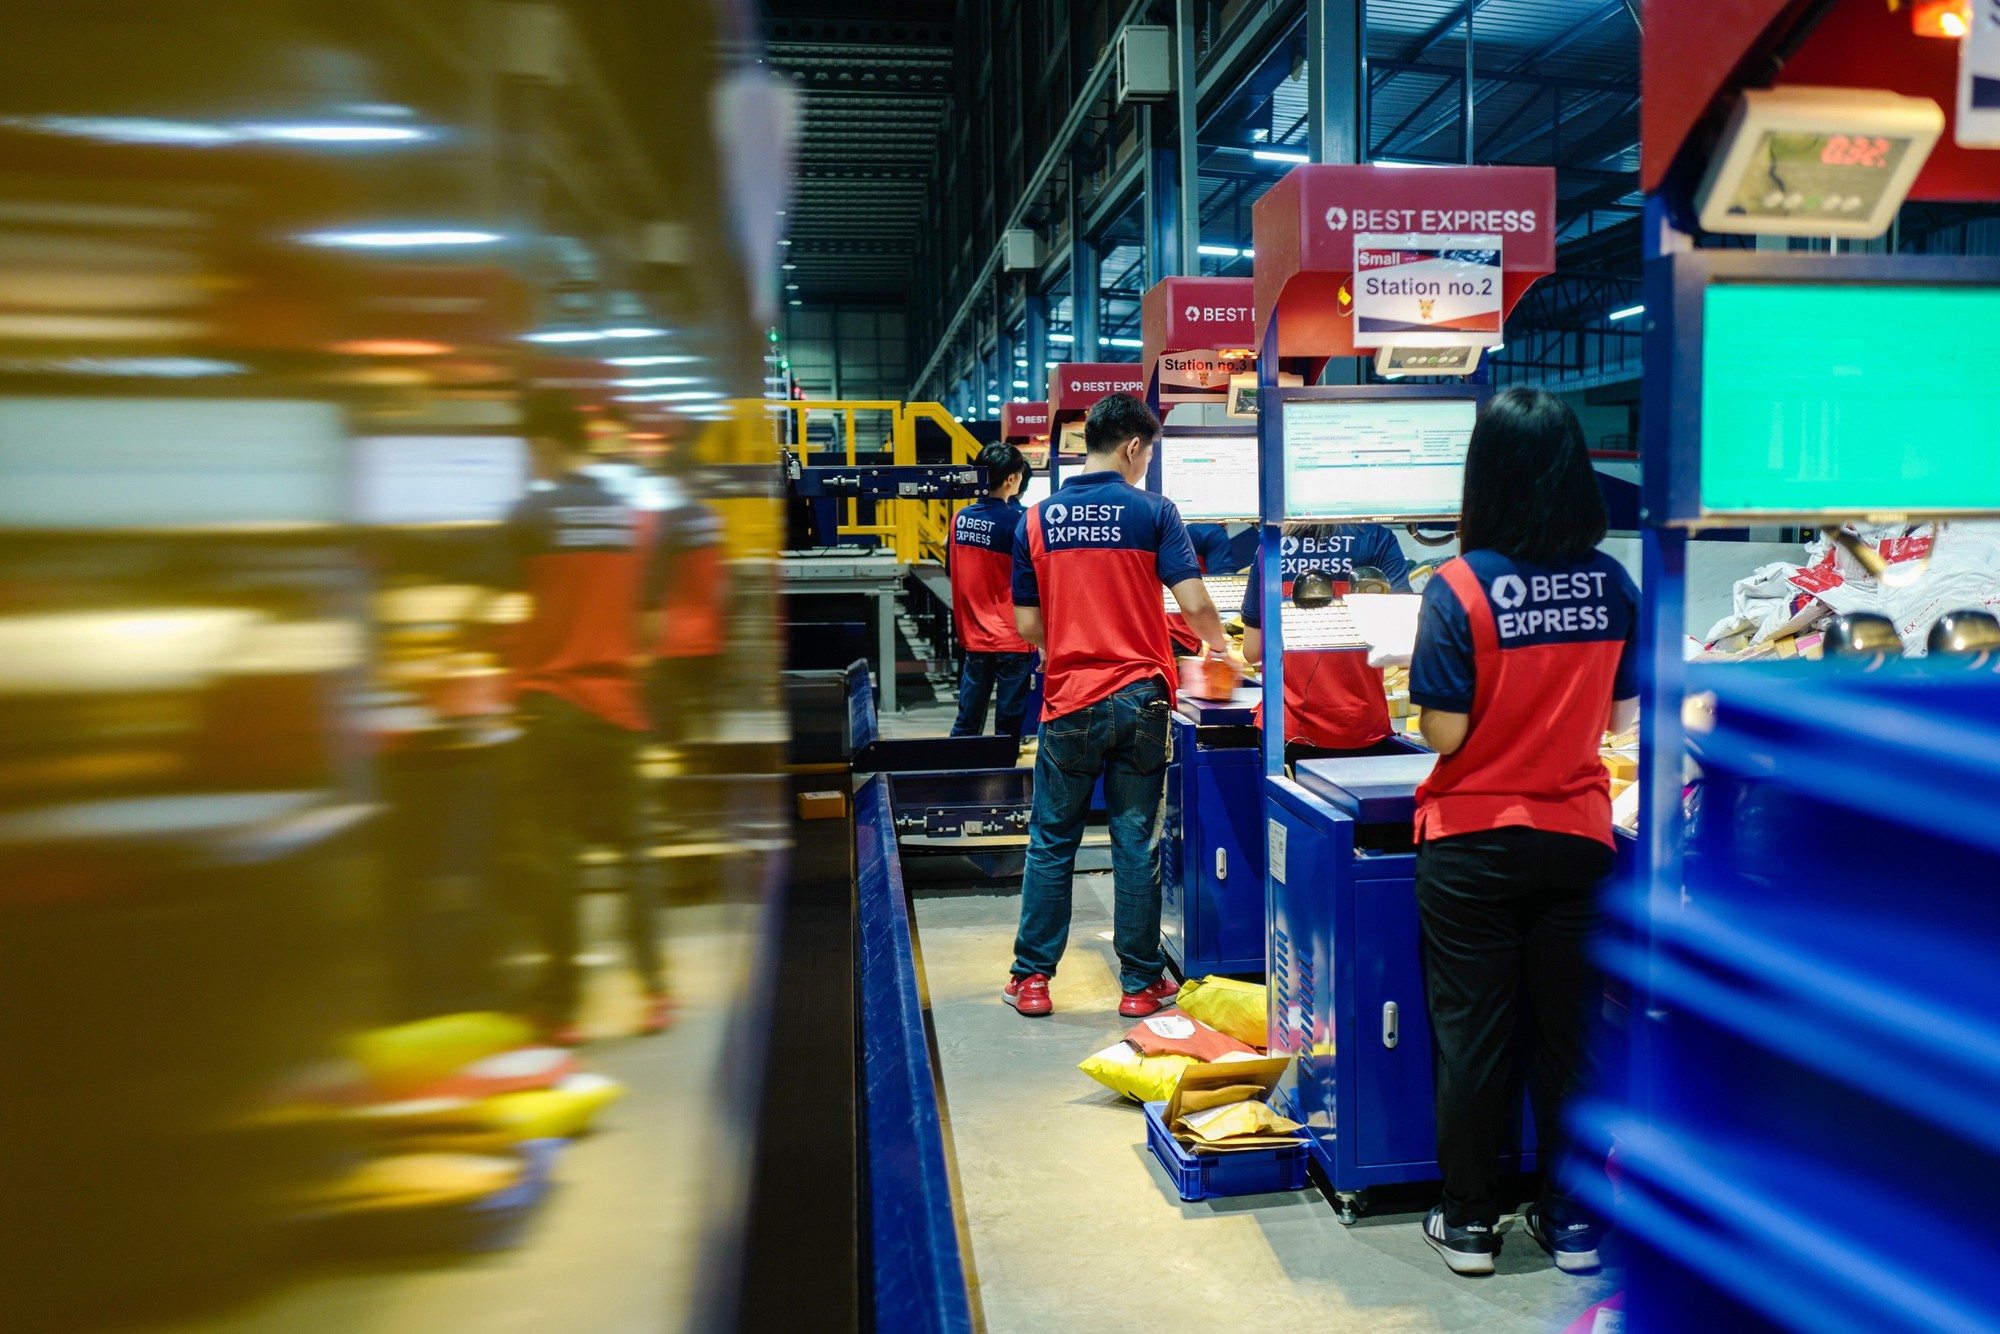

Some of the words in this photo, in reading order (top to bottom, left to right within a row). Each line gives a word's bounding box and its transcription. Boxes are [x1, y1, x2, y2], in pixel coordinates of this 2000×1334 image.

[1353, 209, 1415, 230] BEST
[1421, 210, 1536, 232] EXPRESS
[1359, 251, 1400, 266] Small
[1366, 277, 1440, 296] Station
[1449, 278, 1492, 296] no.2
[1203, 307, 1247, 321] BEST
[1164, 358, 1213, 371] Station
[1217, 360, 1247, 371] no.3
[1083, 381, 1112, 392] BEST
[1114, 381, 1143, 392] EXPR
[1025, 415, 1048, 423] BEST
[1071, 504, 1125, 522] BEST
[966, 518, 995, 533] BEST
[956, 530, 991, 546] EXPRESS
[1047, 526, 1122, 544] EXPRESS
[1302, 535, 1355, 554] BEST
[1531, 571, 1607, 602] BEST
[1497, 605, 1609, 639] EXPRESS
